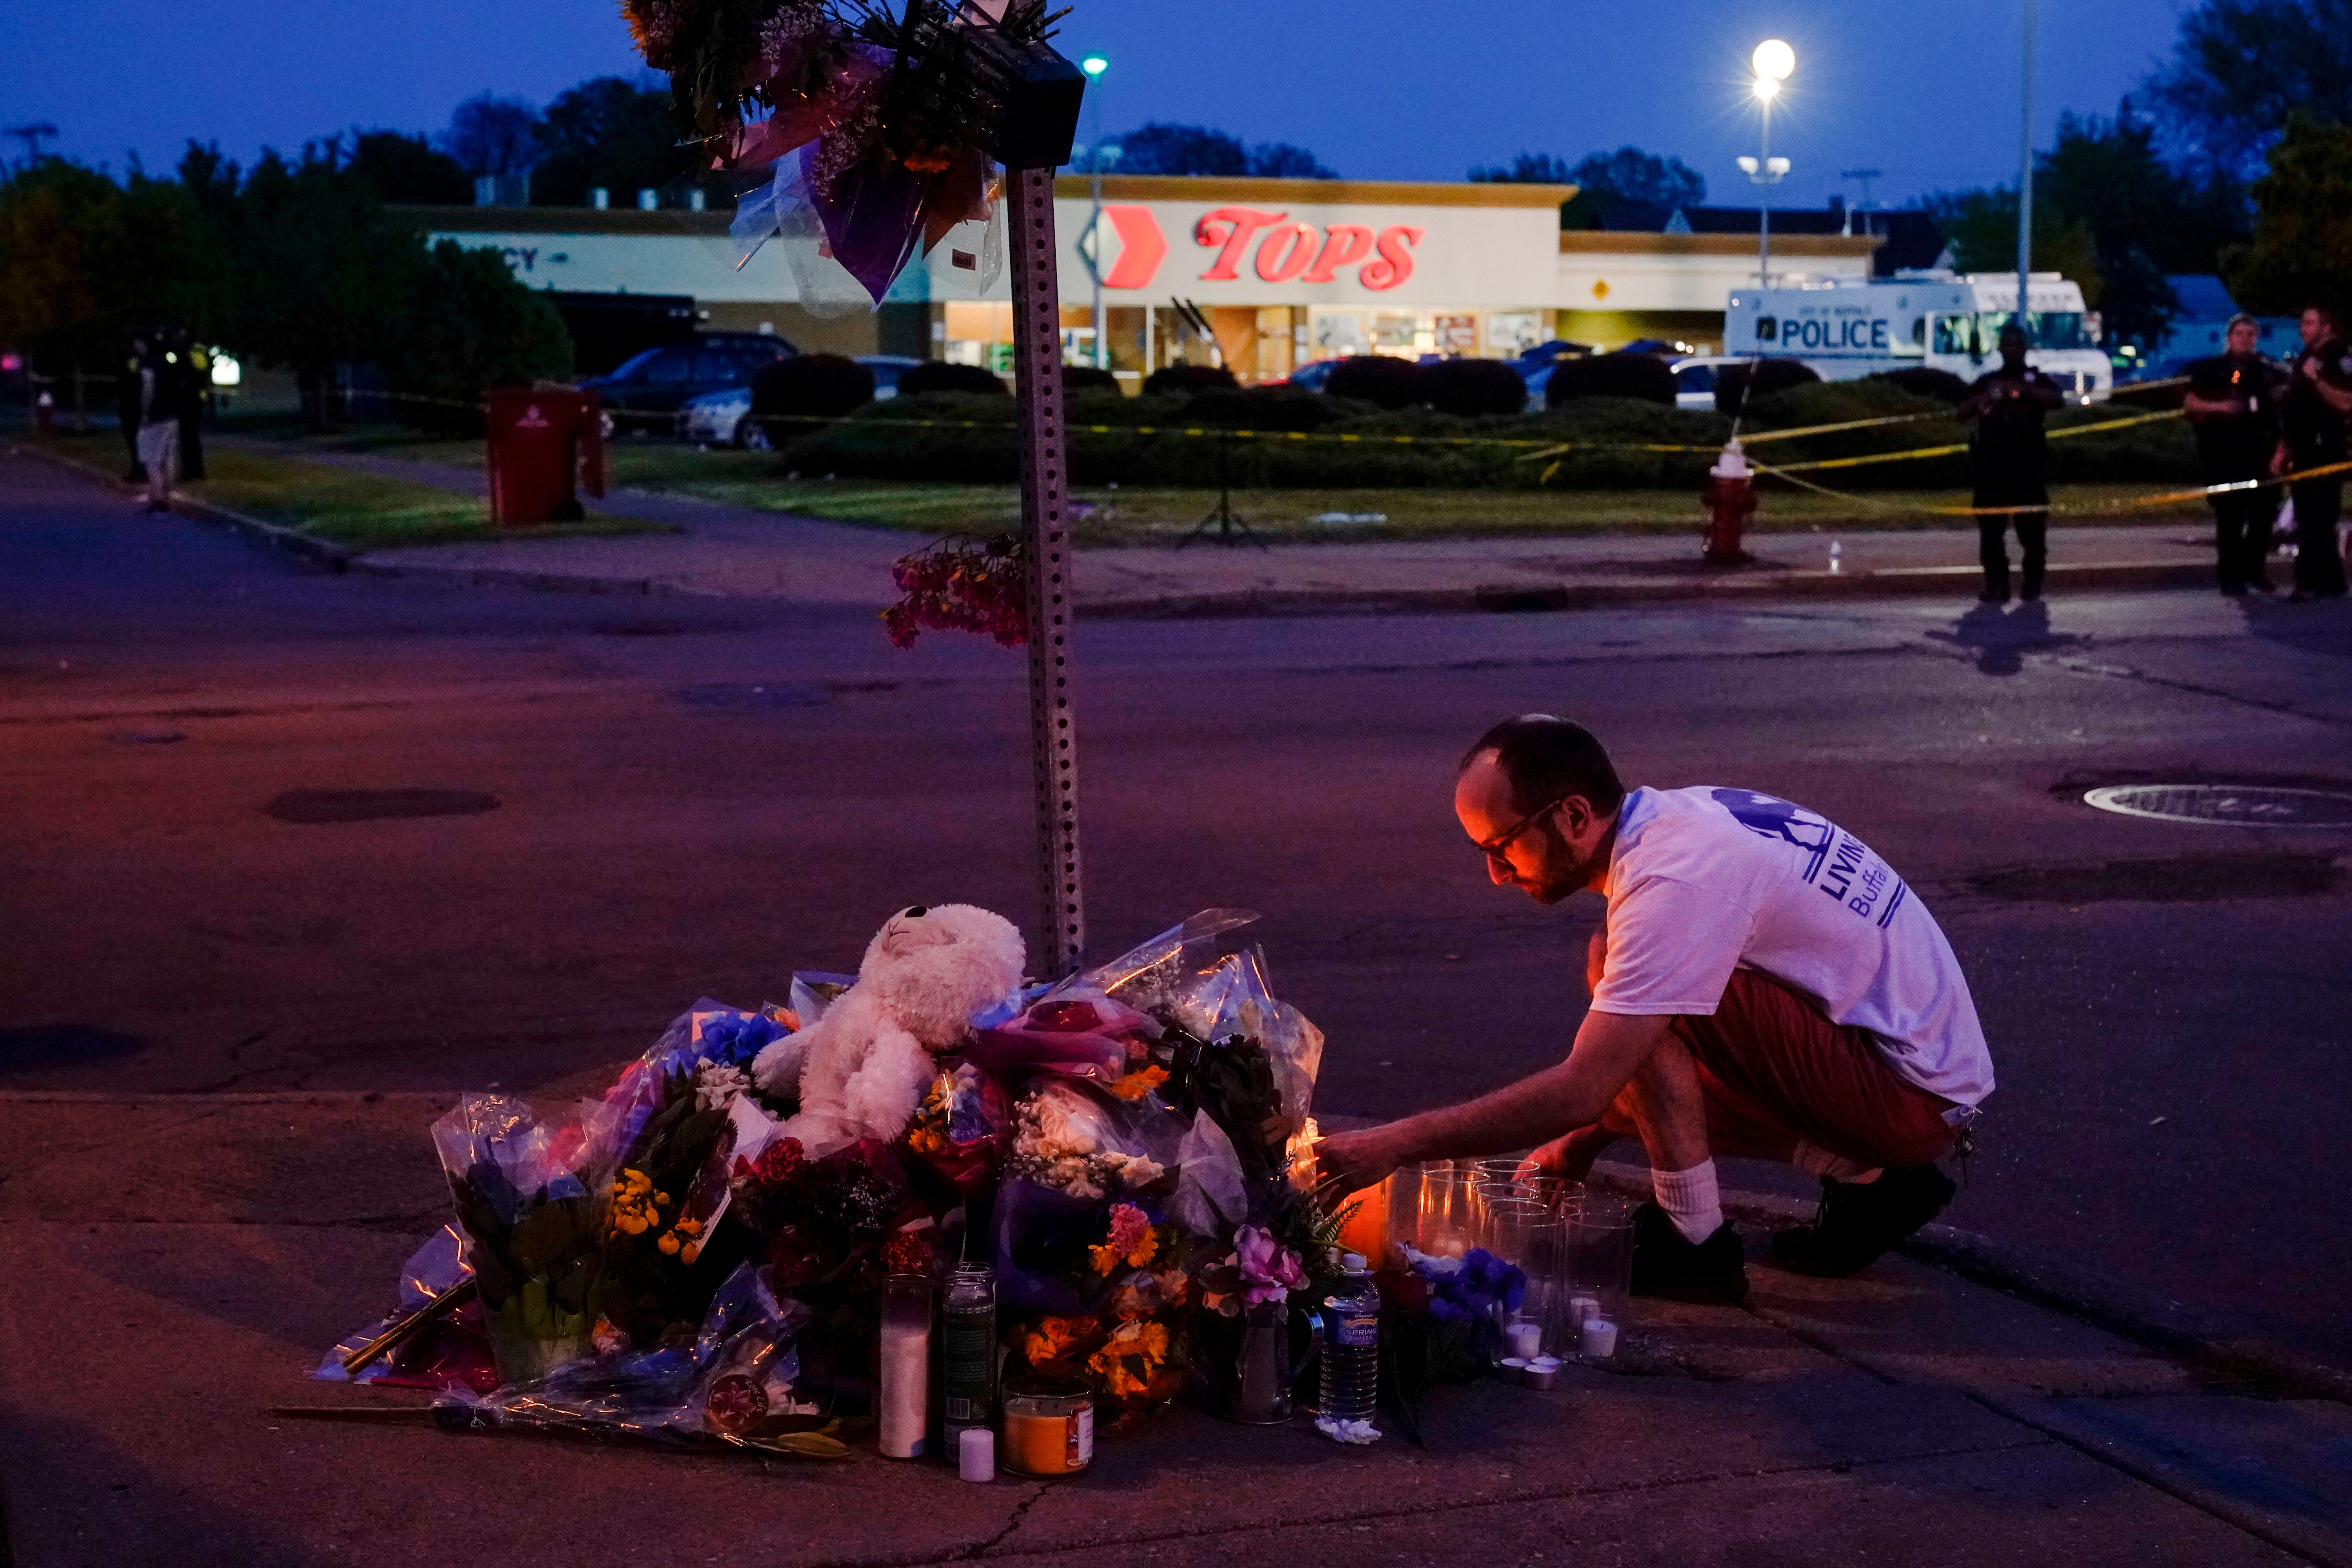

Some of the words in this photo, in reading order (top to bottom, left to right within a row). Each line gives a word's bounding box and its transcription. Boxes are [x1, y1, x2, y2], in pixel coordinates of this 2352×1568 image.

[1196, 206, 1426, 290] TOPS
[1782, 319, 1888, 348] POLICE
[745, 1379, 760, 1394] Rose
